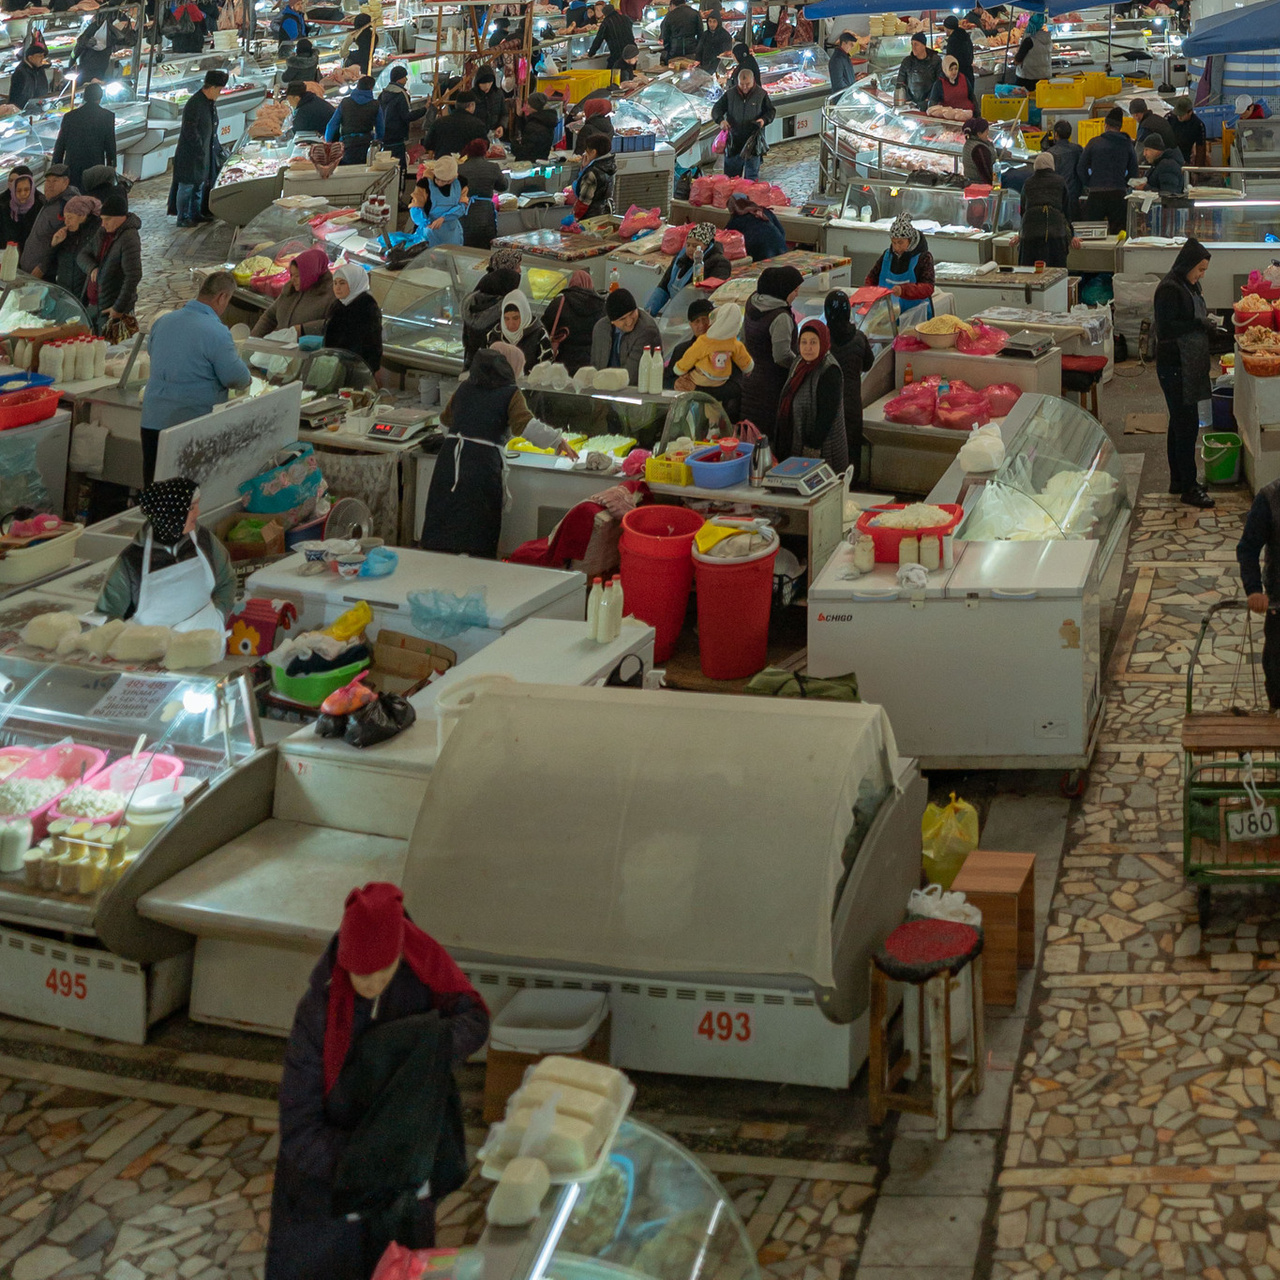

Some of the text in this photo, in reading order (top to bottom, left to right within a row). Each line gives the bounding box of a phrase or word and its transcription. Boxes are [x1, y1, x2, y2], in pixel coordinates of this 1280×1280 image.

[825, 614, 853, 622] CHIGO
[45, 967, 88, 1000] 495
[698, 1010, 752, 1042] 493
